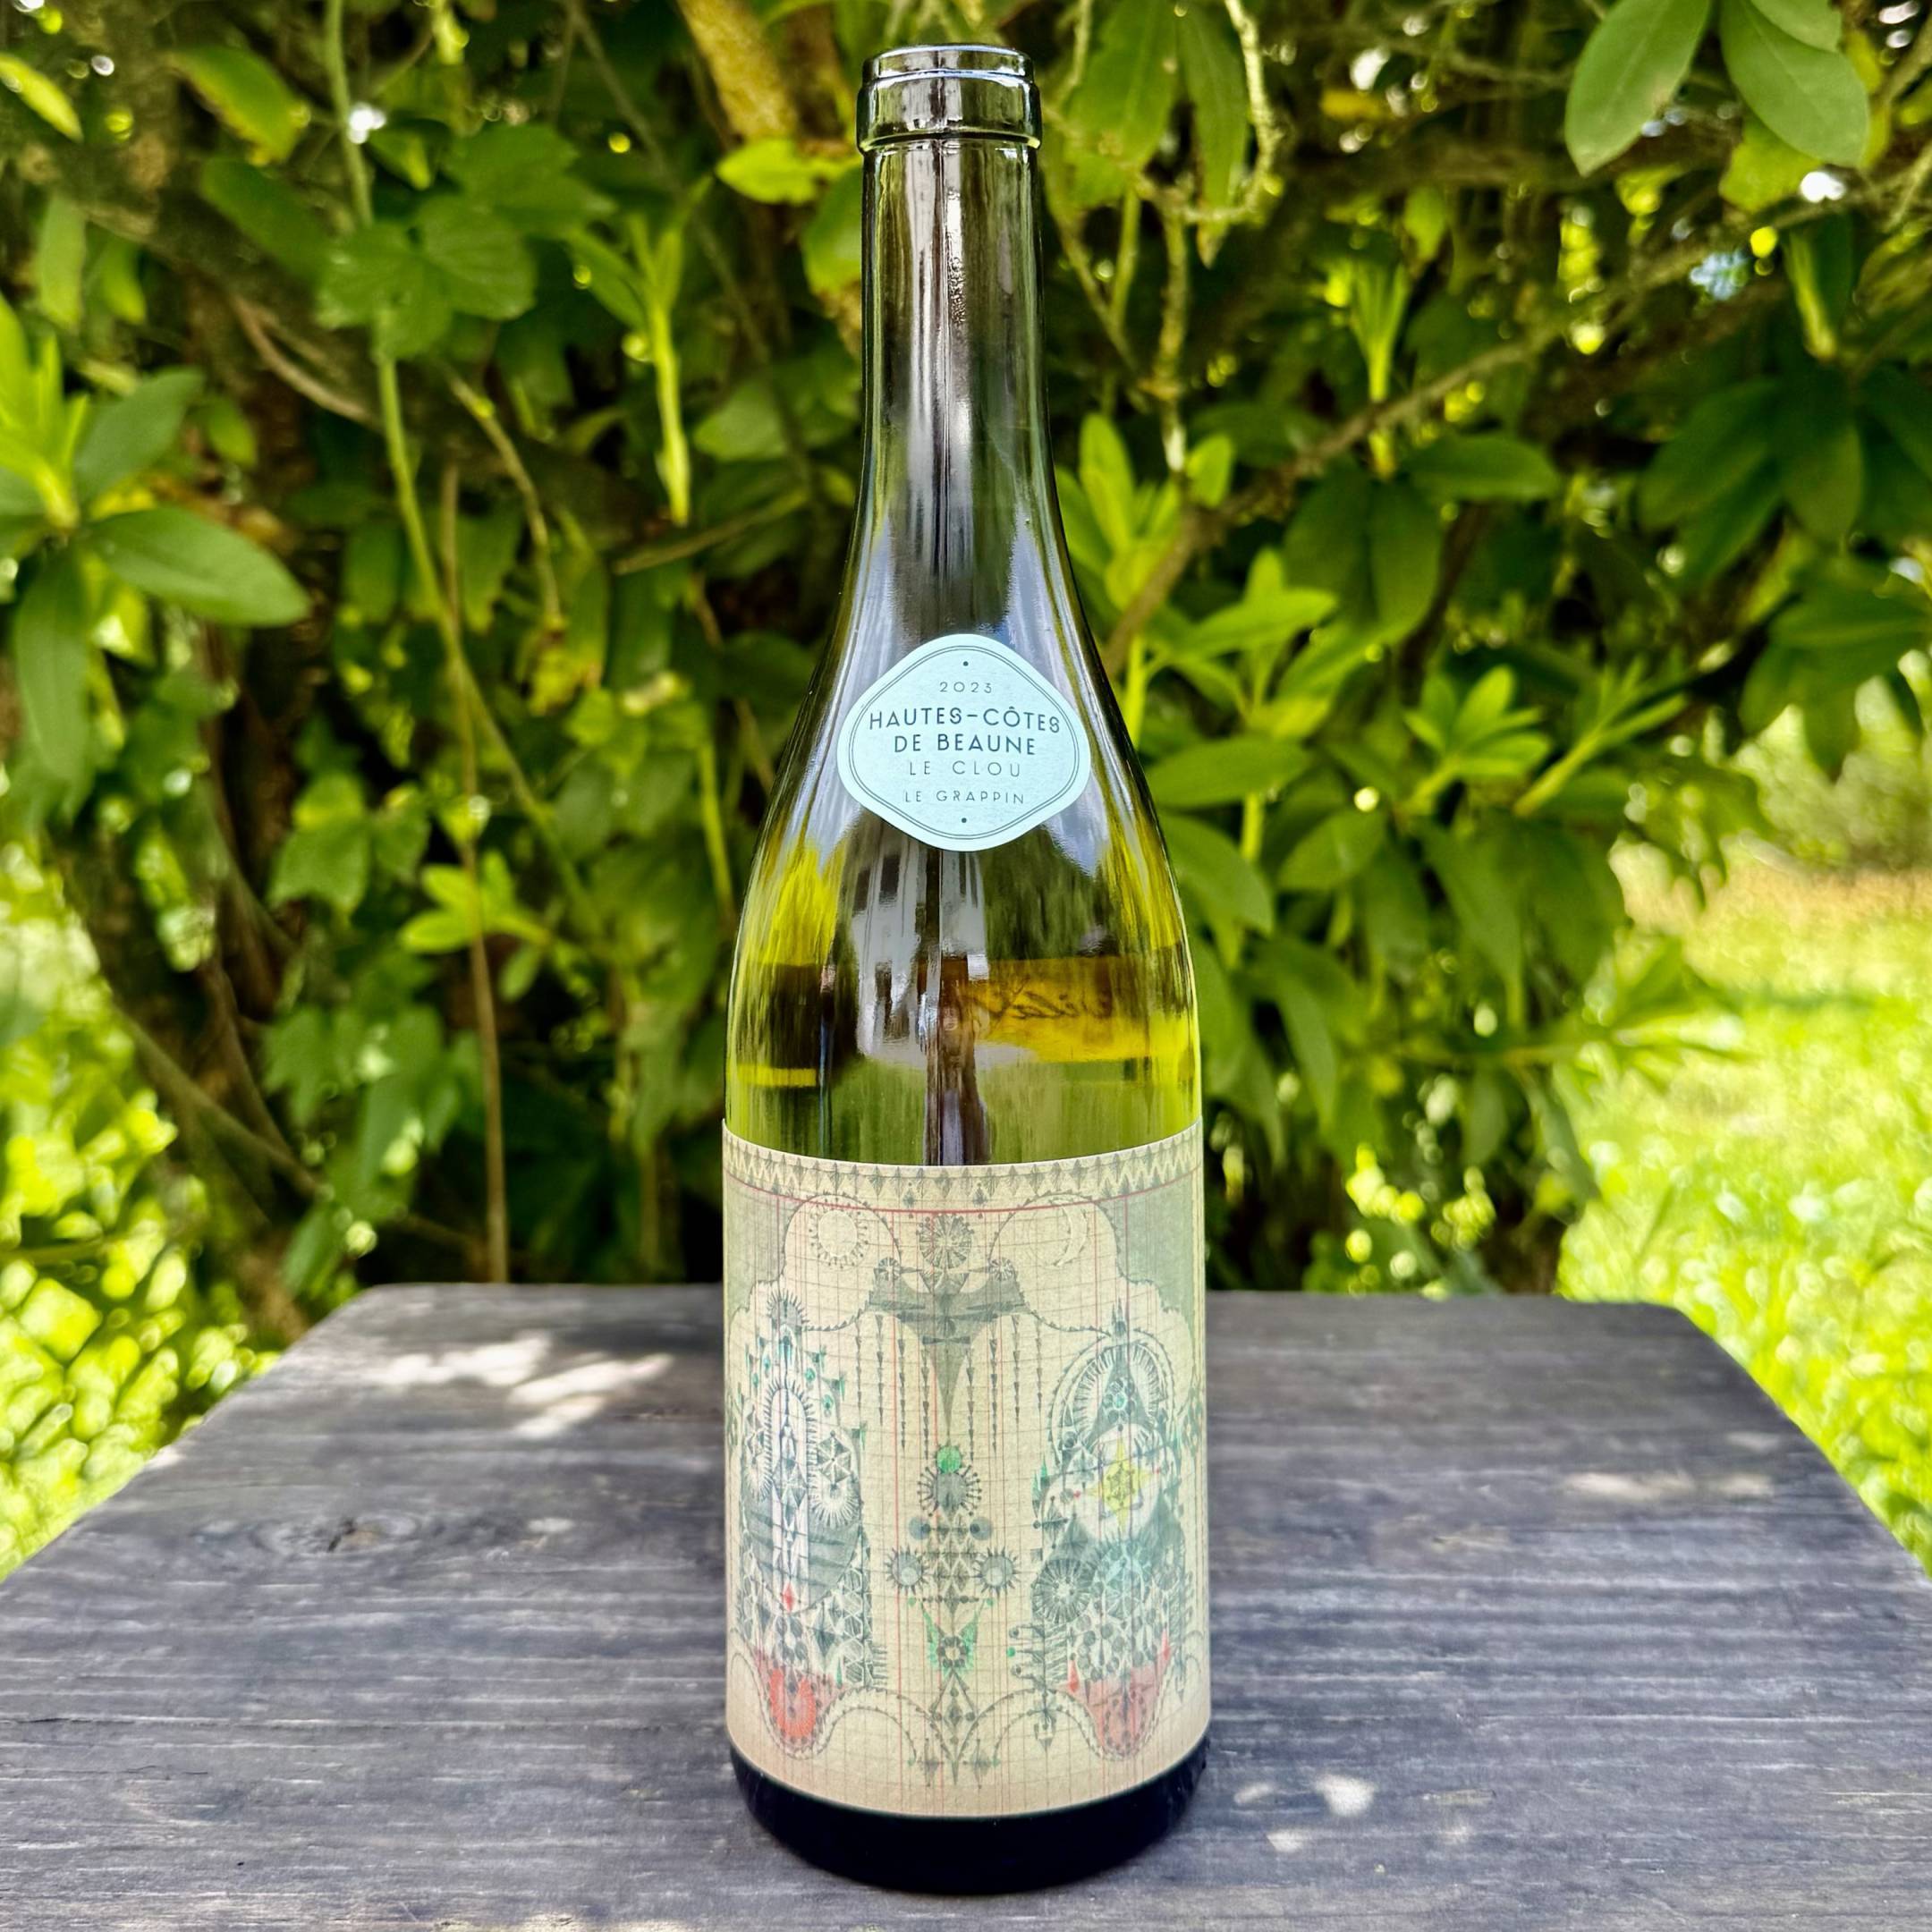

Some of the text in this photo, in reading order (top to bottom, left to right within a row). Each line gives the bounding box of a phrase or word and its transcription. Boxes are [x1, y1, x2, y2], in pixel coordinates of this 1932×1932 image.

[939, 682, 993, 694] 2023
[869, 706, 1061, 733] HAUTES-CÔTES
[894, 733, 1036, 755] DE BEAUNE
[909, 760, 1021, 777] LE CLOU
[904, 790, 1024, 804] LE GRAPPIN
